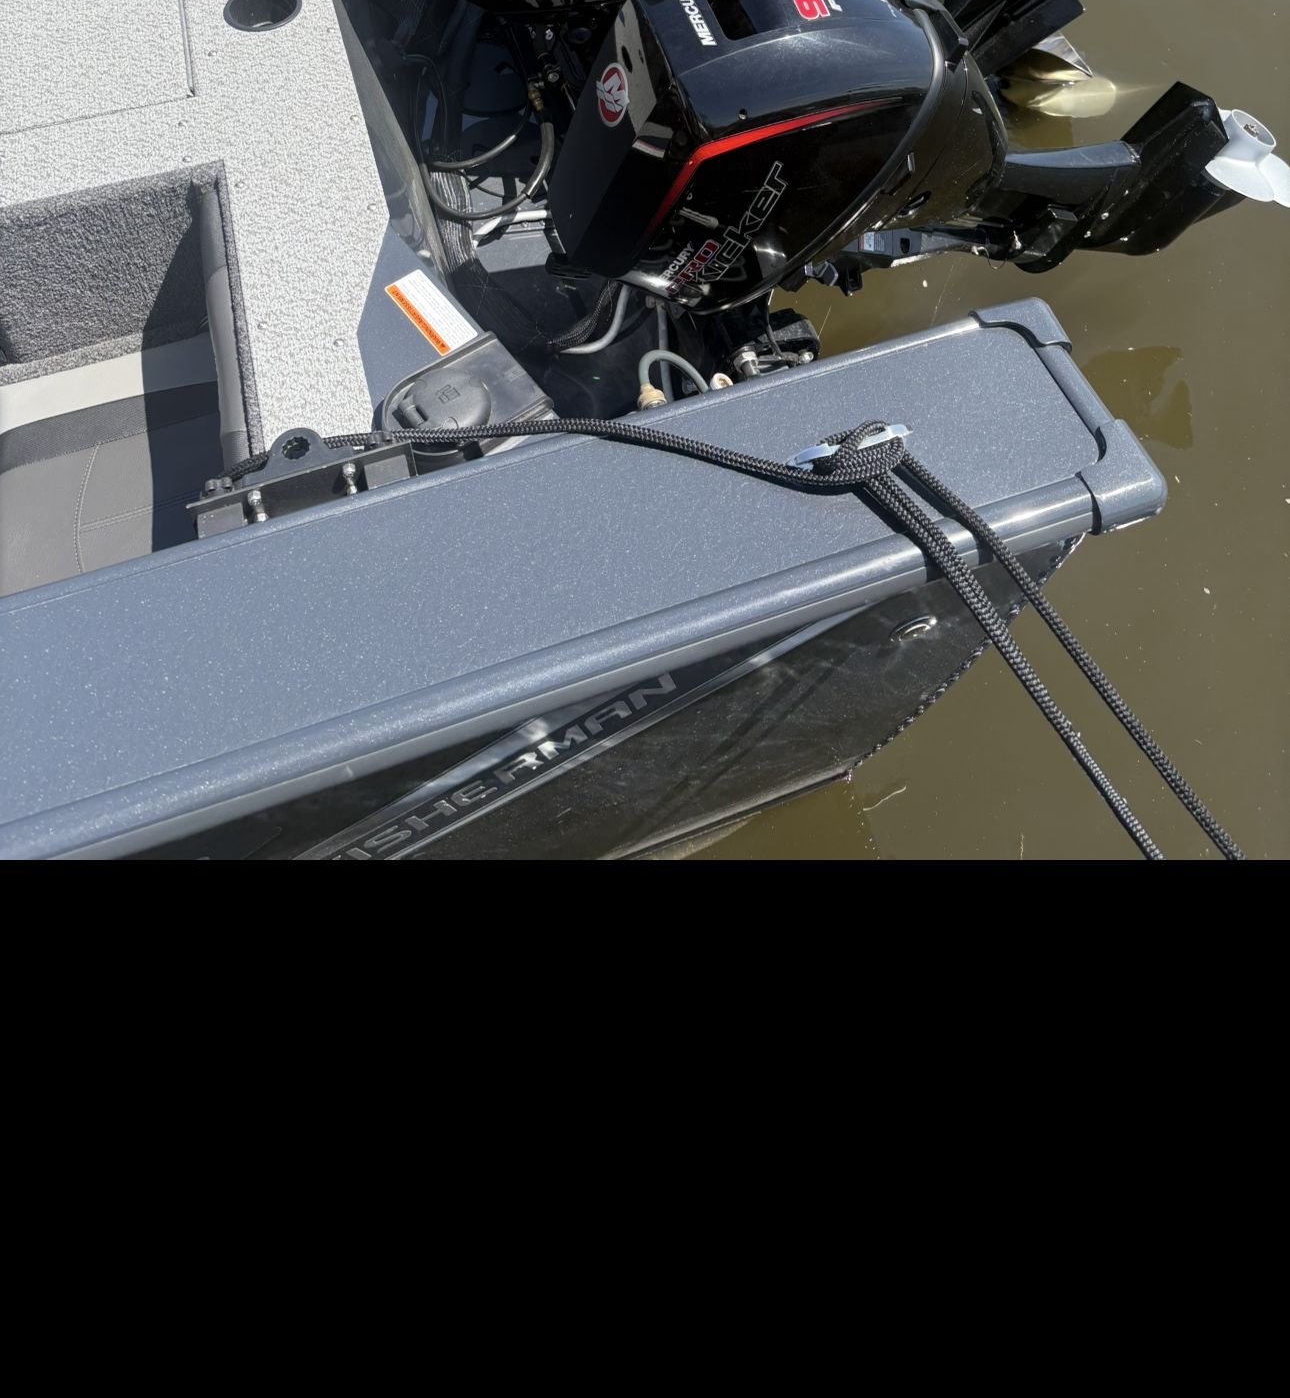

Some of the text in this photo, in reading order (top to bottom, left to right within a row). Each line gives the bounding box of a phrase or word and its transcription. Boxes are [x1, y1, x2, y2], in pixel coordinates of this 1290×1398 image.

[655, 242, 697, 283] ERCURY
[665, 239, 721, 294] PRO
[332, 672, 678, 859] ISHERMAN
